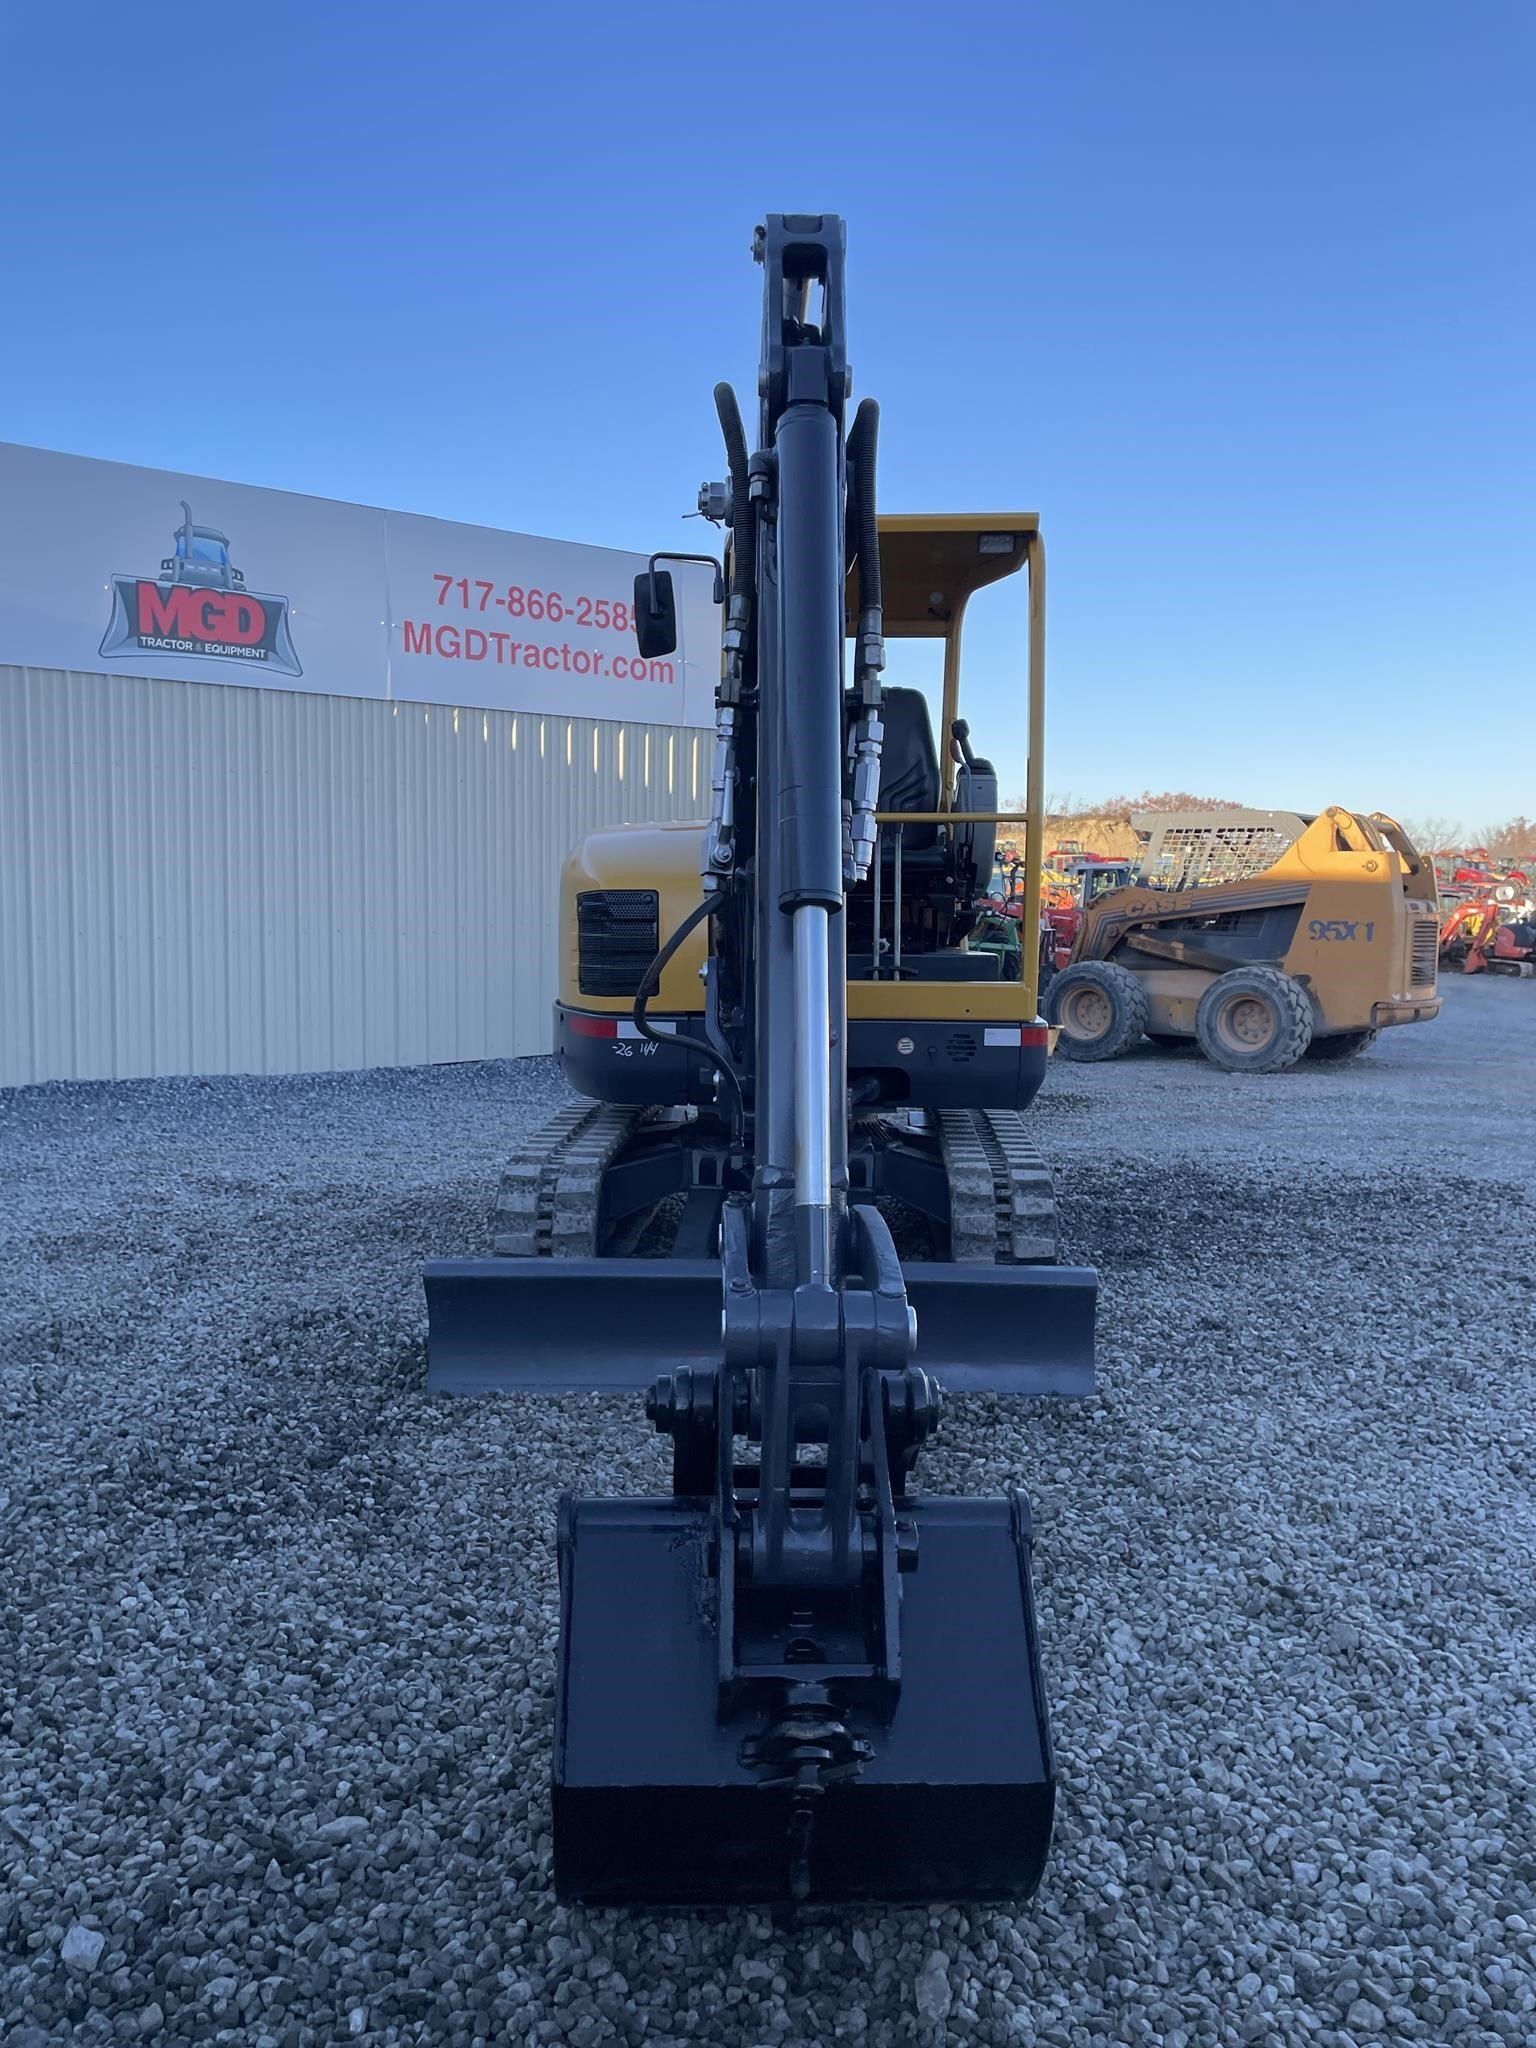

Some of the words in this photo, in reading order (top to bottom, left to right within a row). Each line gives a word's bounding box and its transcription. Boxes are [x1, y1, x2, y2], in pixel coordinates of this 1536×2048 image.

[136, 580, 266, 644] MGD
[140, 636, 193, 651] TRACTOR
[205, 643, 266, 659] EQUIPMENT
[403, 620, 674, 684] MGDTractor.com
[1124, 893, 1192, 917] CASE
